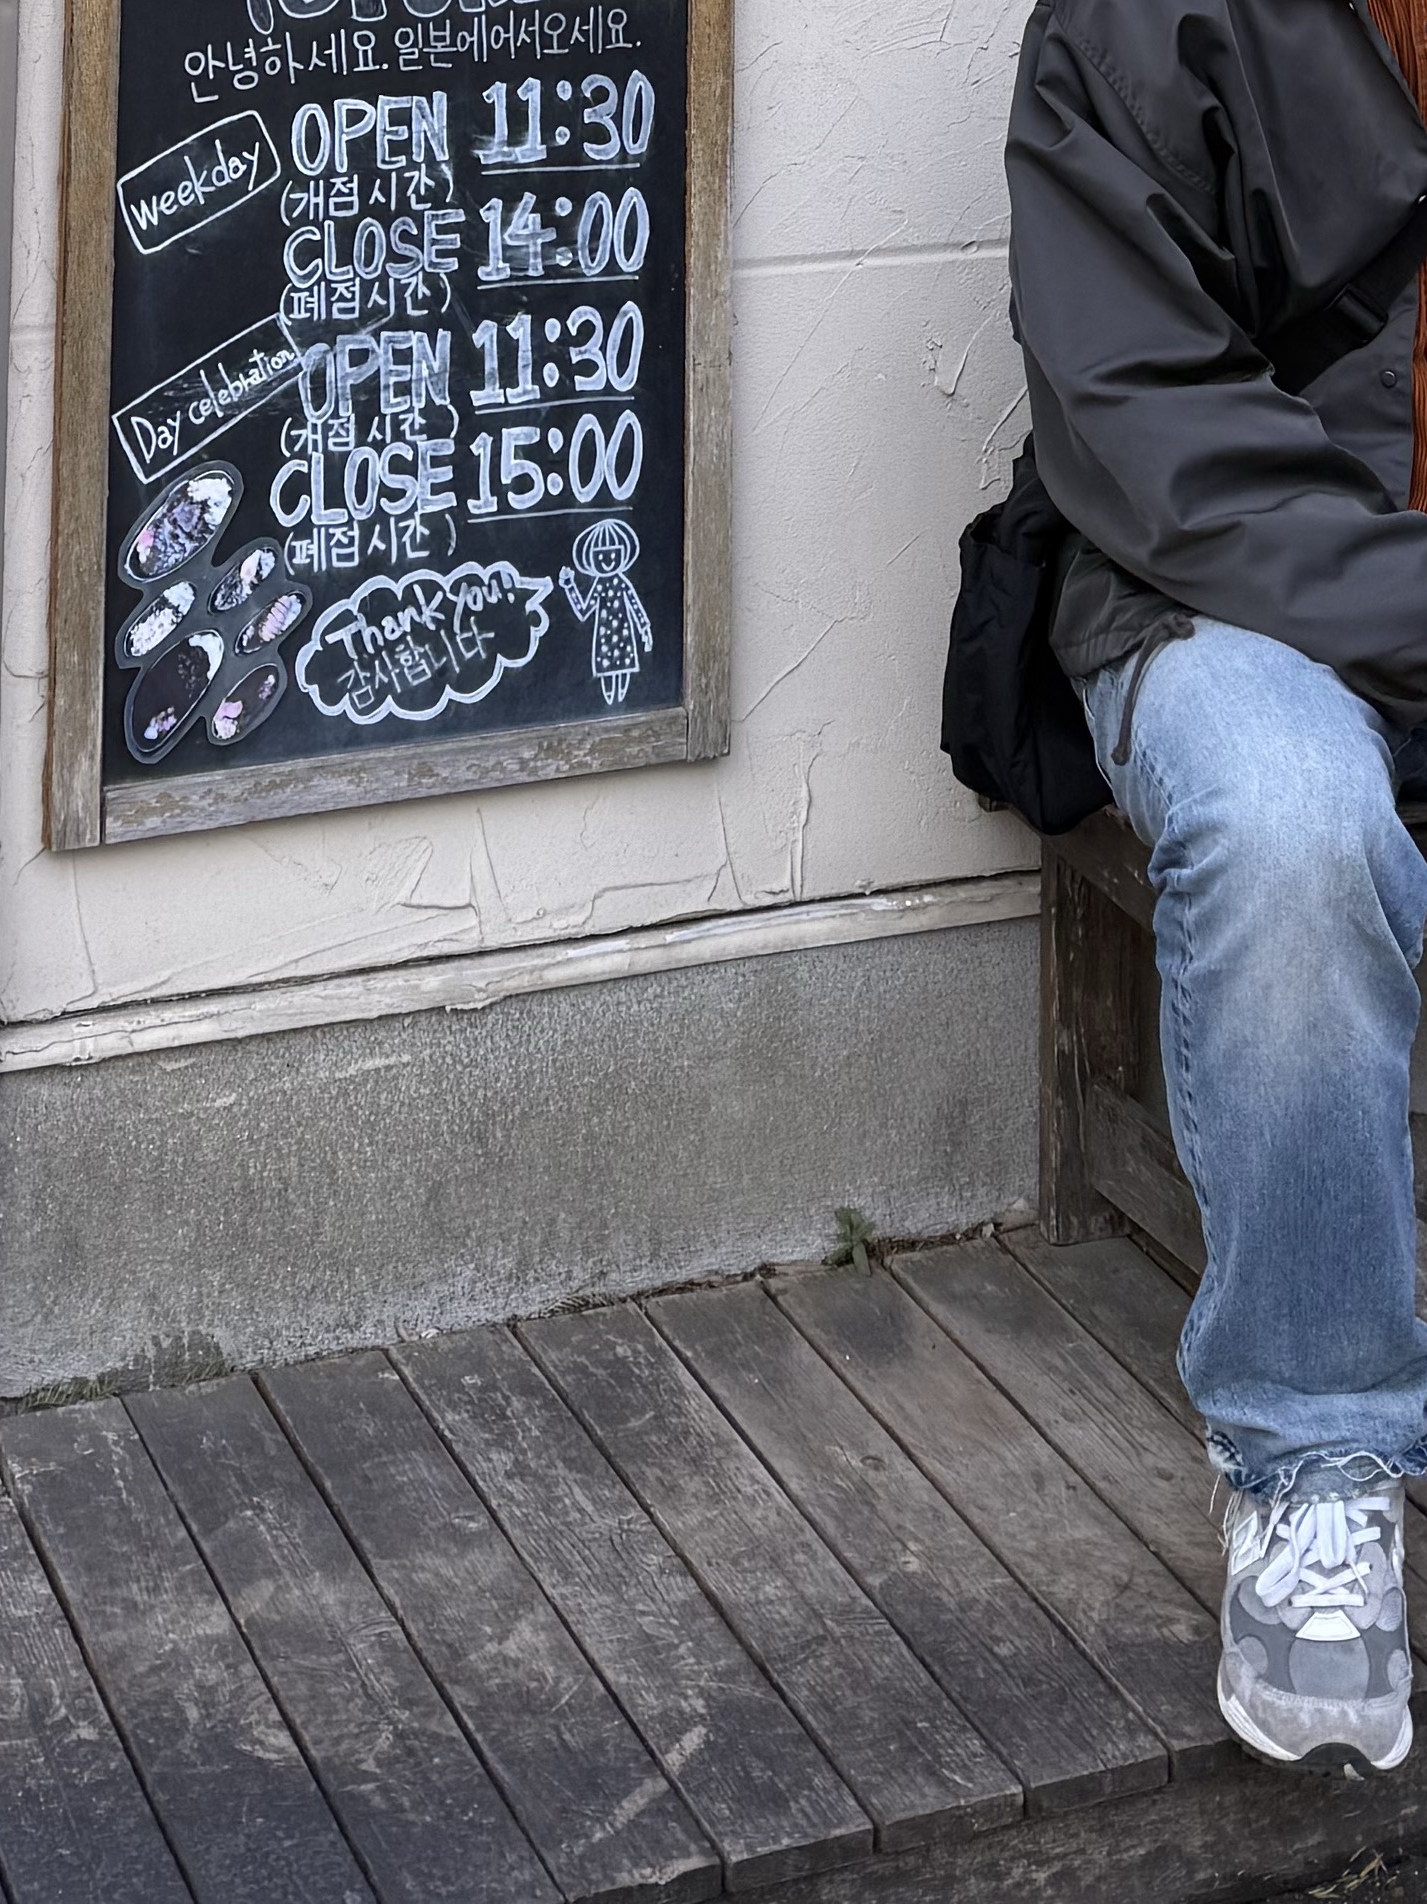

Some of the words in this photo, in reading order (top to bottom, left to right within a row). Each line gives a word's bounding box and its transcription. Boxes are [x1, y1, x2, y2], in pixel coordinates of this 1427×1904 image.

[290, 90, 451, 177] OPEN
[475, 69, 657, 165] 11:30
[128, 139, 261, 232] weekday
[282, 208, 467, 289] CLOSE
[476, 186, 651, 283] 14:00
[130, 413, 181, 465] Day
[188, 347, 297, 426] celebration
[297, 328, 452, 424] OPEN
[469, 300, 645, 407] 11:30
[270, 438, 458, 528] CLOSE
[466, 408, 644, 515] 15:00
[324, 583, 446, 660] Thank
[336, 616, 496, 710] 감사합니다
